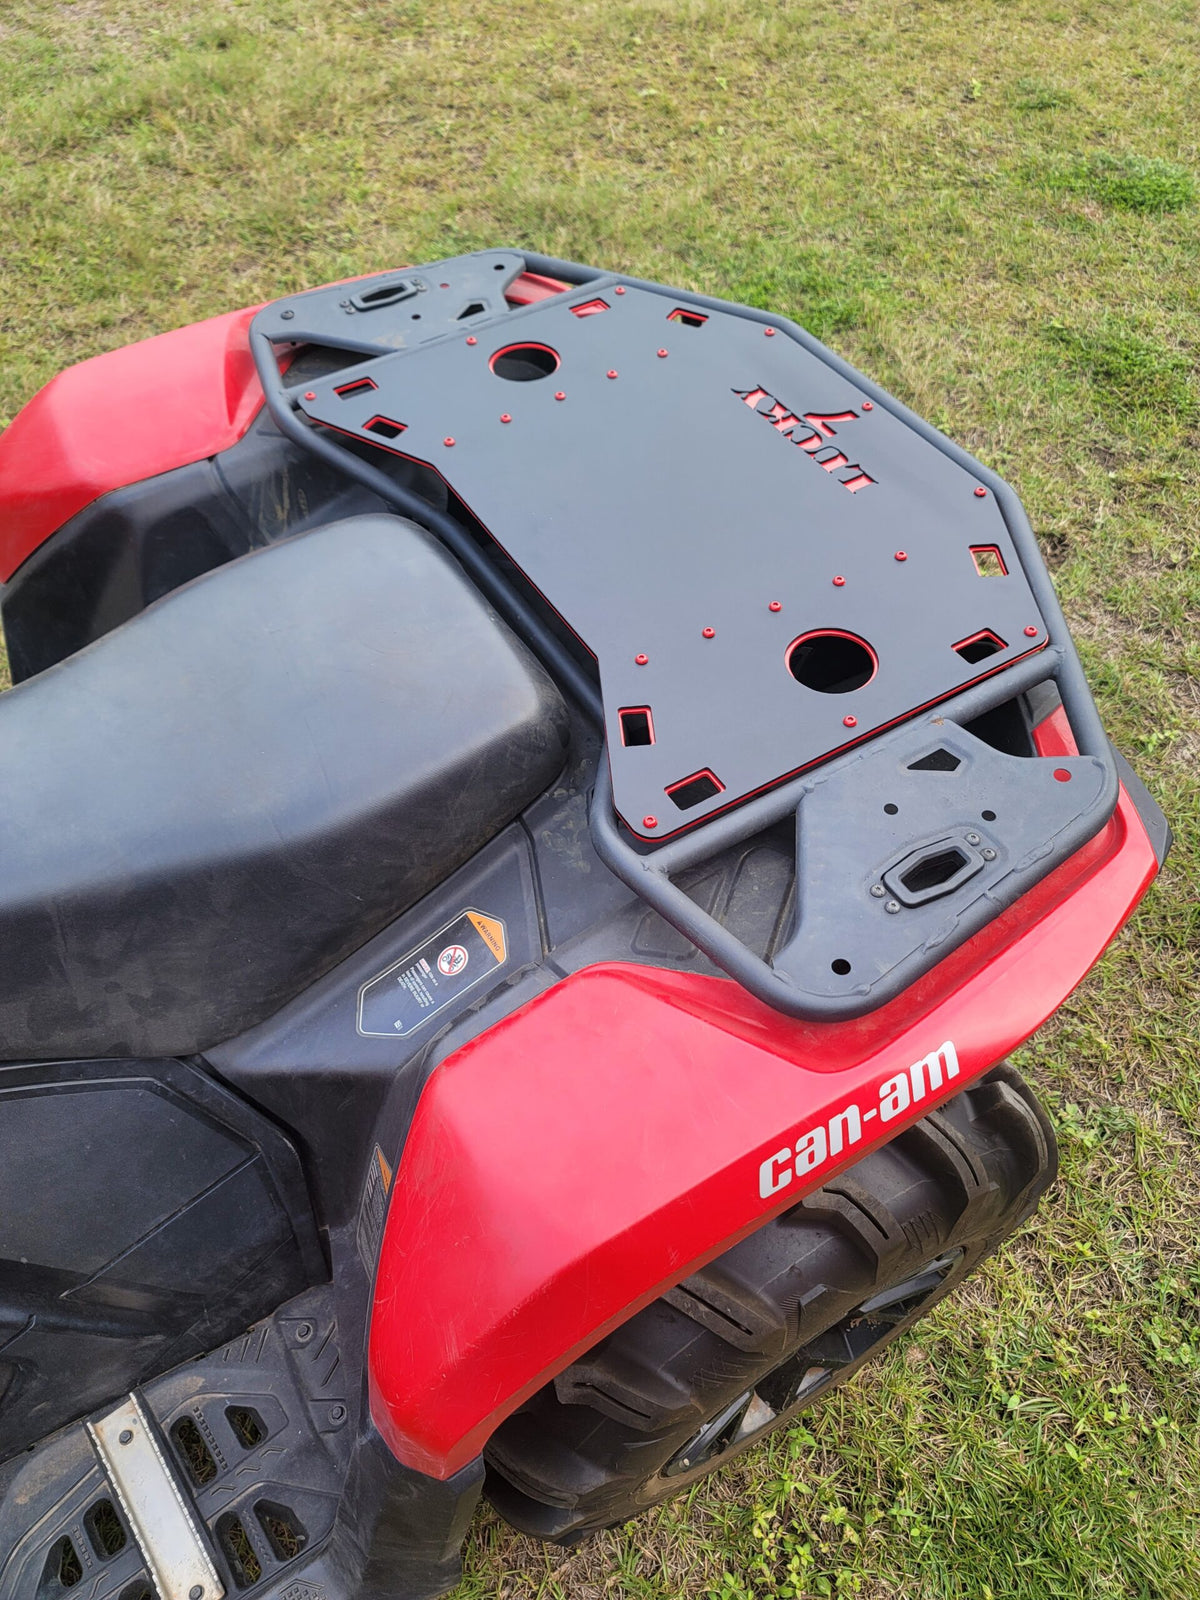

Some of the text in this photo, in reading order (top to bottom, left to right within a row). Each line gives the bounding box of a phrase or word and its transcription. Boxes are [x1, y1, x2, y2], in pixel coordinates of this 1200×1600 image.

[731, 384, 879, 494] LUCKY
[480, 924, 501, 951] WARNING
[759, 1040, 960, 1199] can-am
